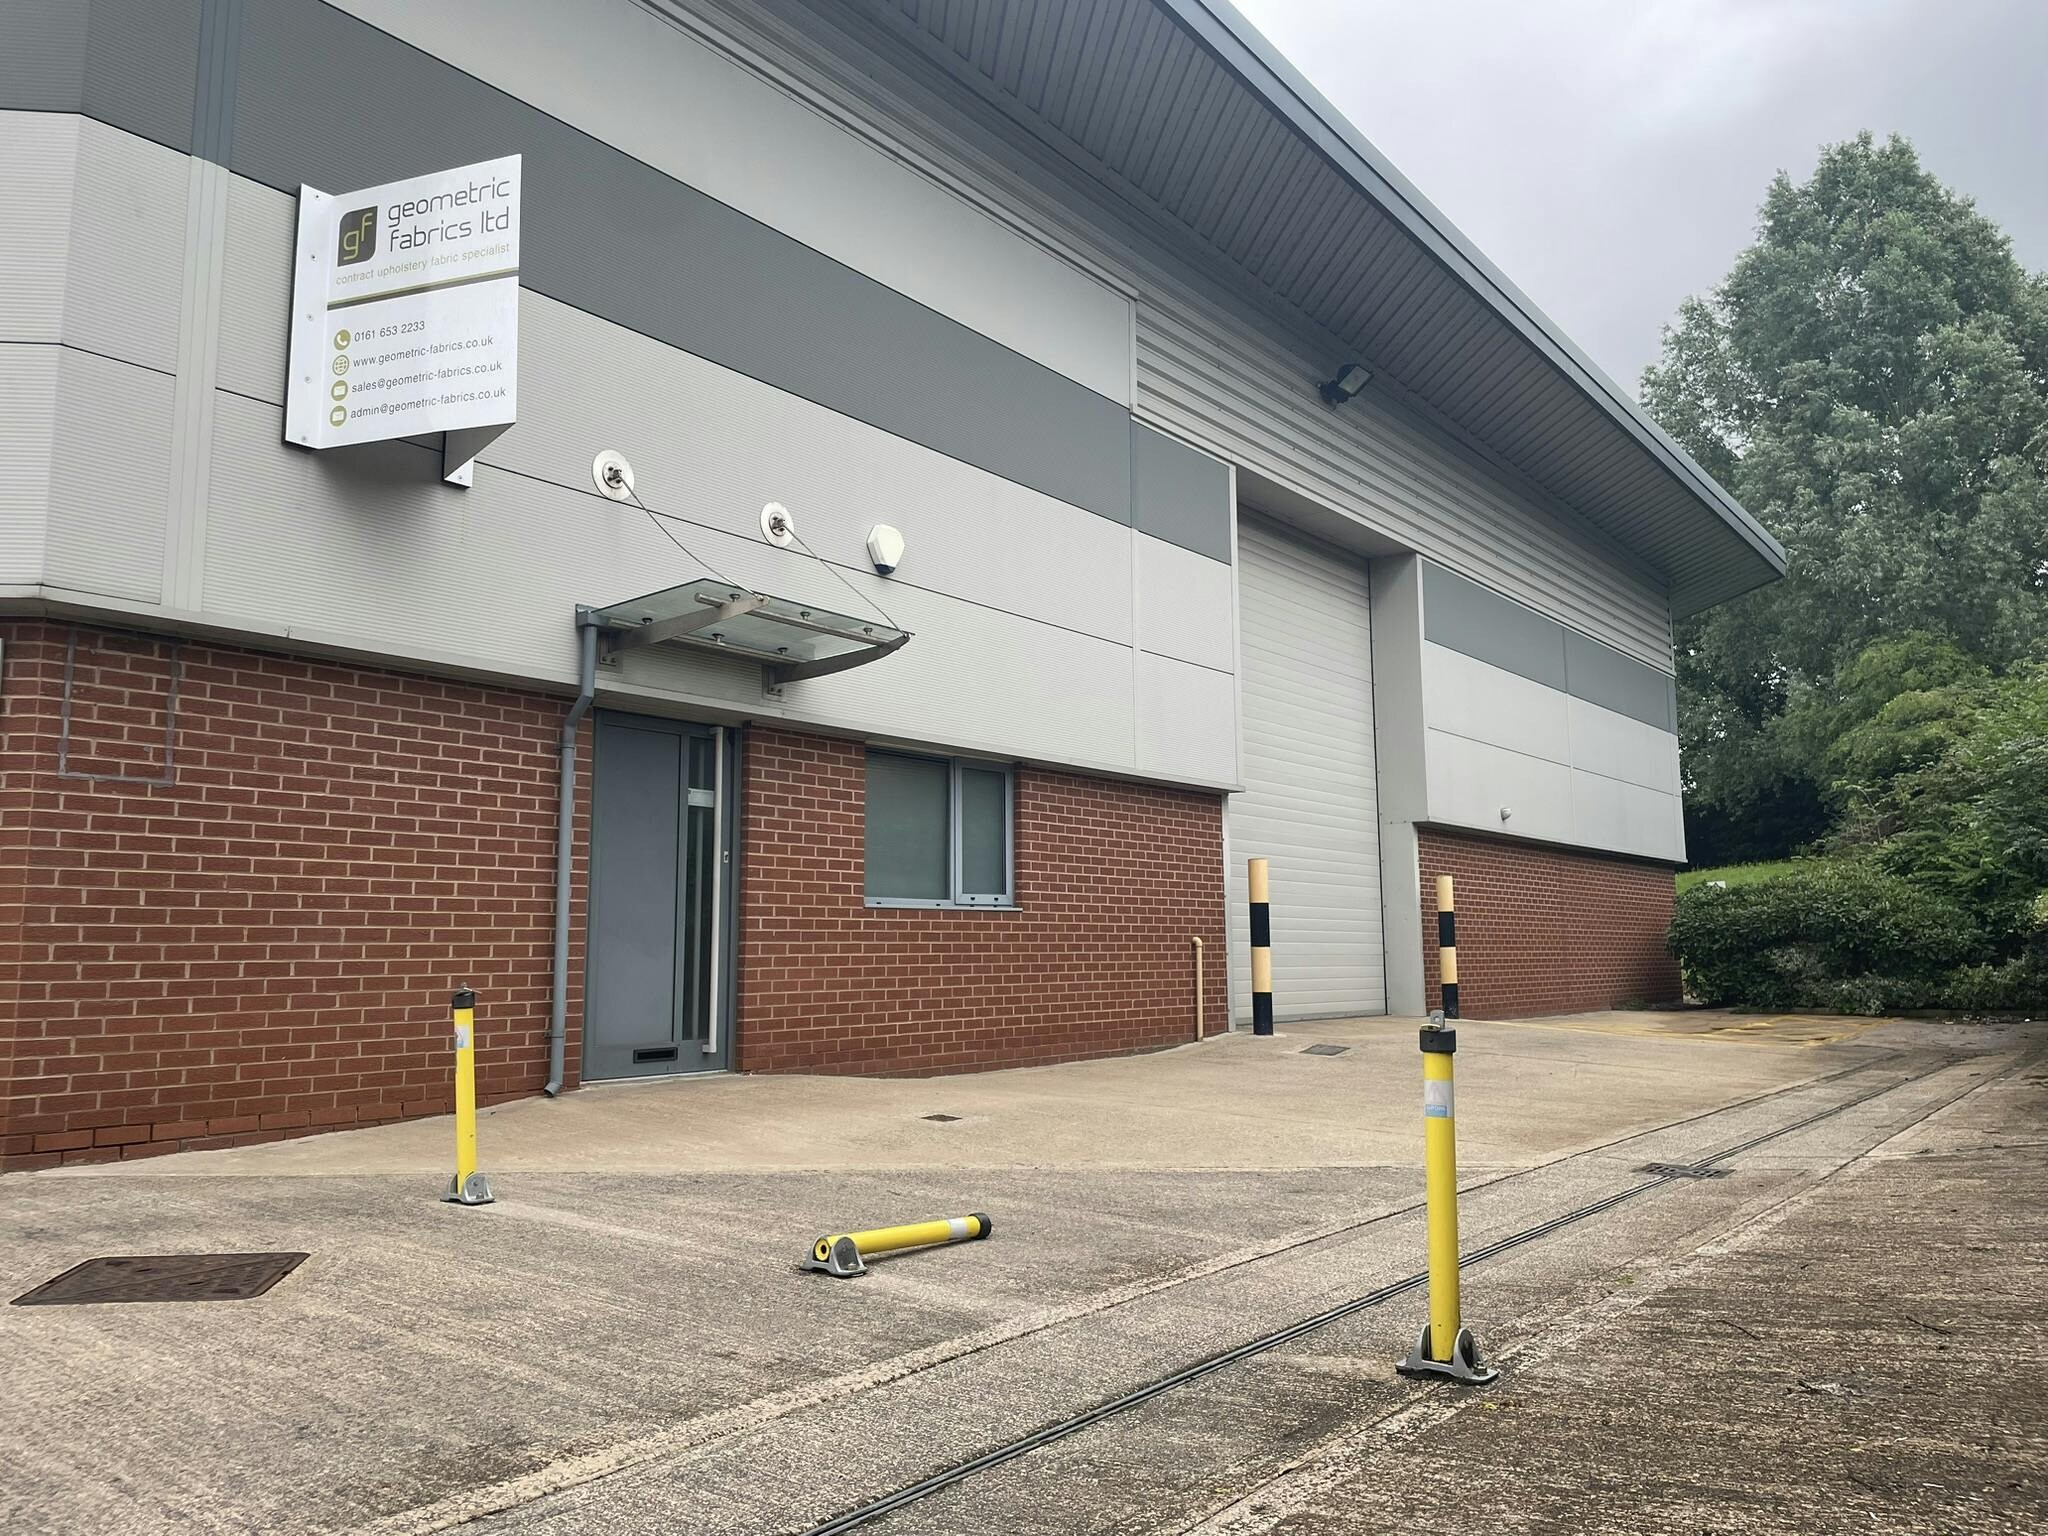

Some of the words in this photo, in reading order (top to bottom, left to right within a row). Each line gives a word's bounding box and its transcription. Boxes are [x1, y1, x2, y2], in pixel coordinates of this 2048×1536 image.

[388, 177, 510, 228] geometric
[390, 220, 472, 252] fabrics
[480, 206, 510, 234] ltd
[336, 270, 374, 285] contract
[377, 258, 428, 278] upholstery
[430, 251, 459, 267] fabric
[461, 243, 510, 262] specialist
[354, 330, 376, 343] 0161
[379, 325, 398, 338] 653
[401, 320, 426, 335] 2233
[353, 336, 493, 368] www.geometric-fabrics.co.uk
[351, 360, 502, 393] sales@geometric-fabrics.co.uk
[350, 387, 506, 419] admin@geometric-fabrics.co.uk
